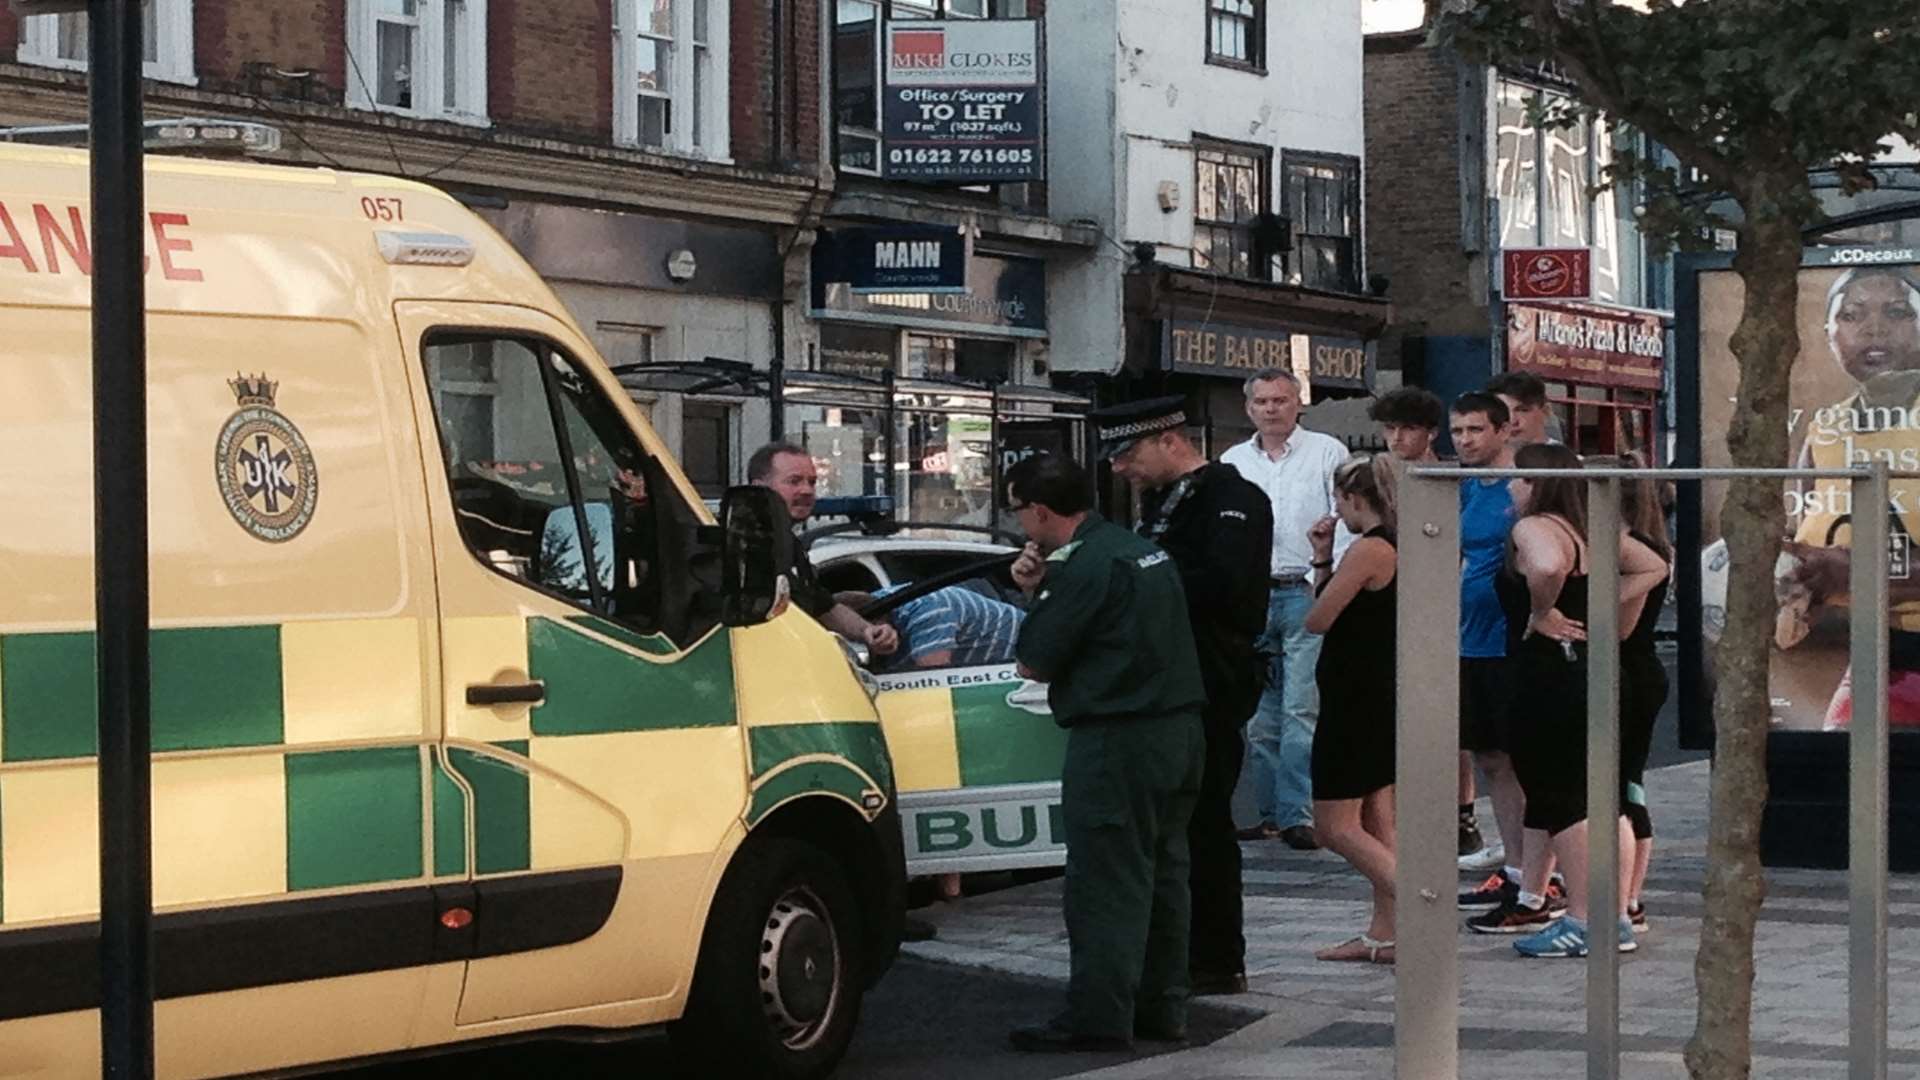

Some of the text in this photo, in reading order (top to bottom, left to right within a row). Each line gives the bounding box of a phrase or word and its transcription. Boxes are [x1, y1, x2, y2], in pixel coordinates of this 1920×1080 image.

[894, 53, 1032, 68] MKH CLOKES
[900, 89, 1025, 104] Office/Surgery
[920, 104, 1006, 120] TO LET
[890, 149, 1033, 164] 01622 761605
[361, 196, 403, 222] 057
[875, 241, 941, 268] MANN
[1830, 248, 1913, 263] JCDecaux
[1172, 329, 1218, 365] THE
[1223, 334, 1291, 370] BARBE
[880, 678, 940, 692] South
[947, 673, 991, 687] East
[915, 804, 1063, 853] BU
